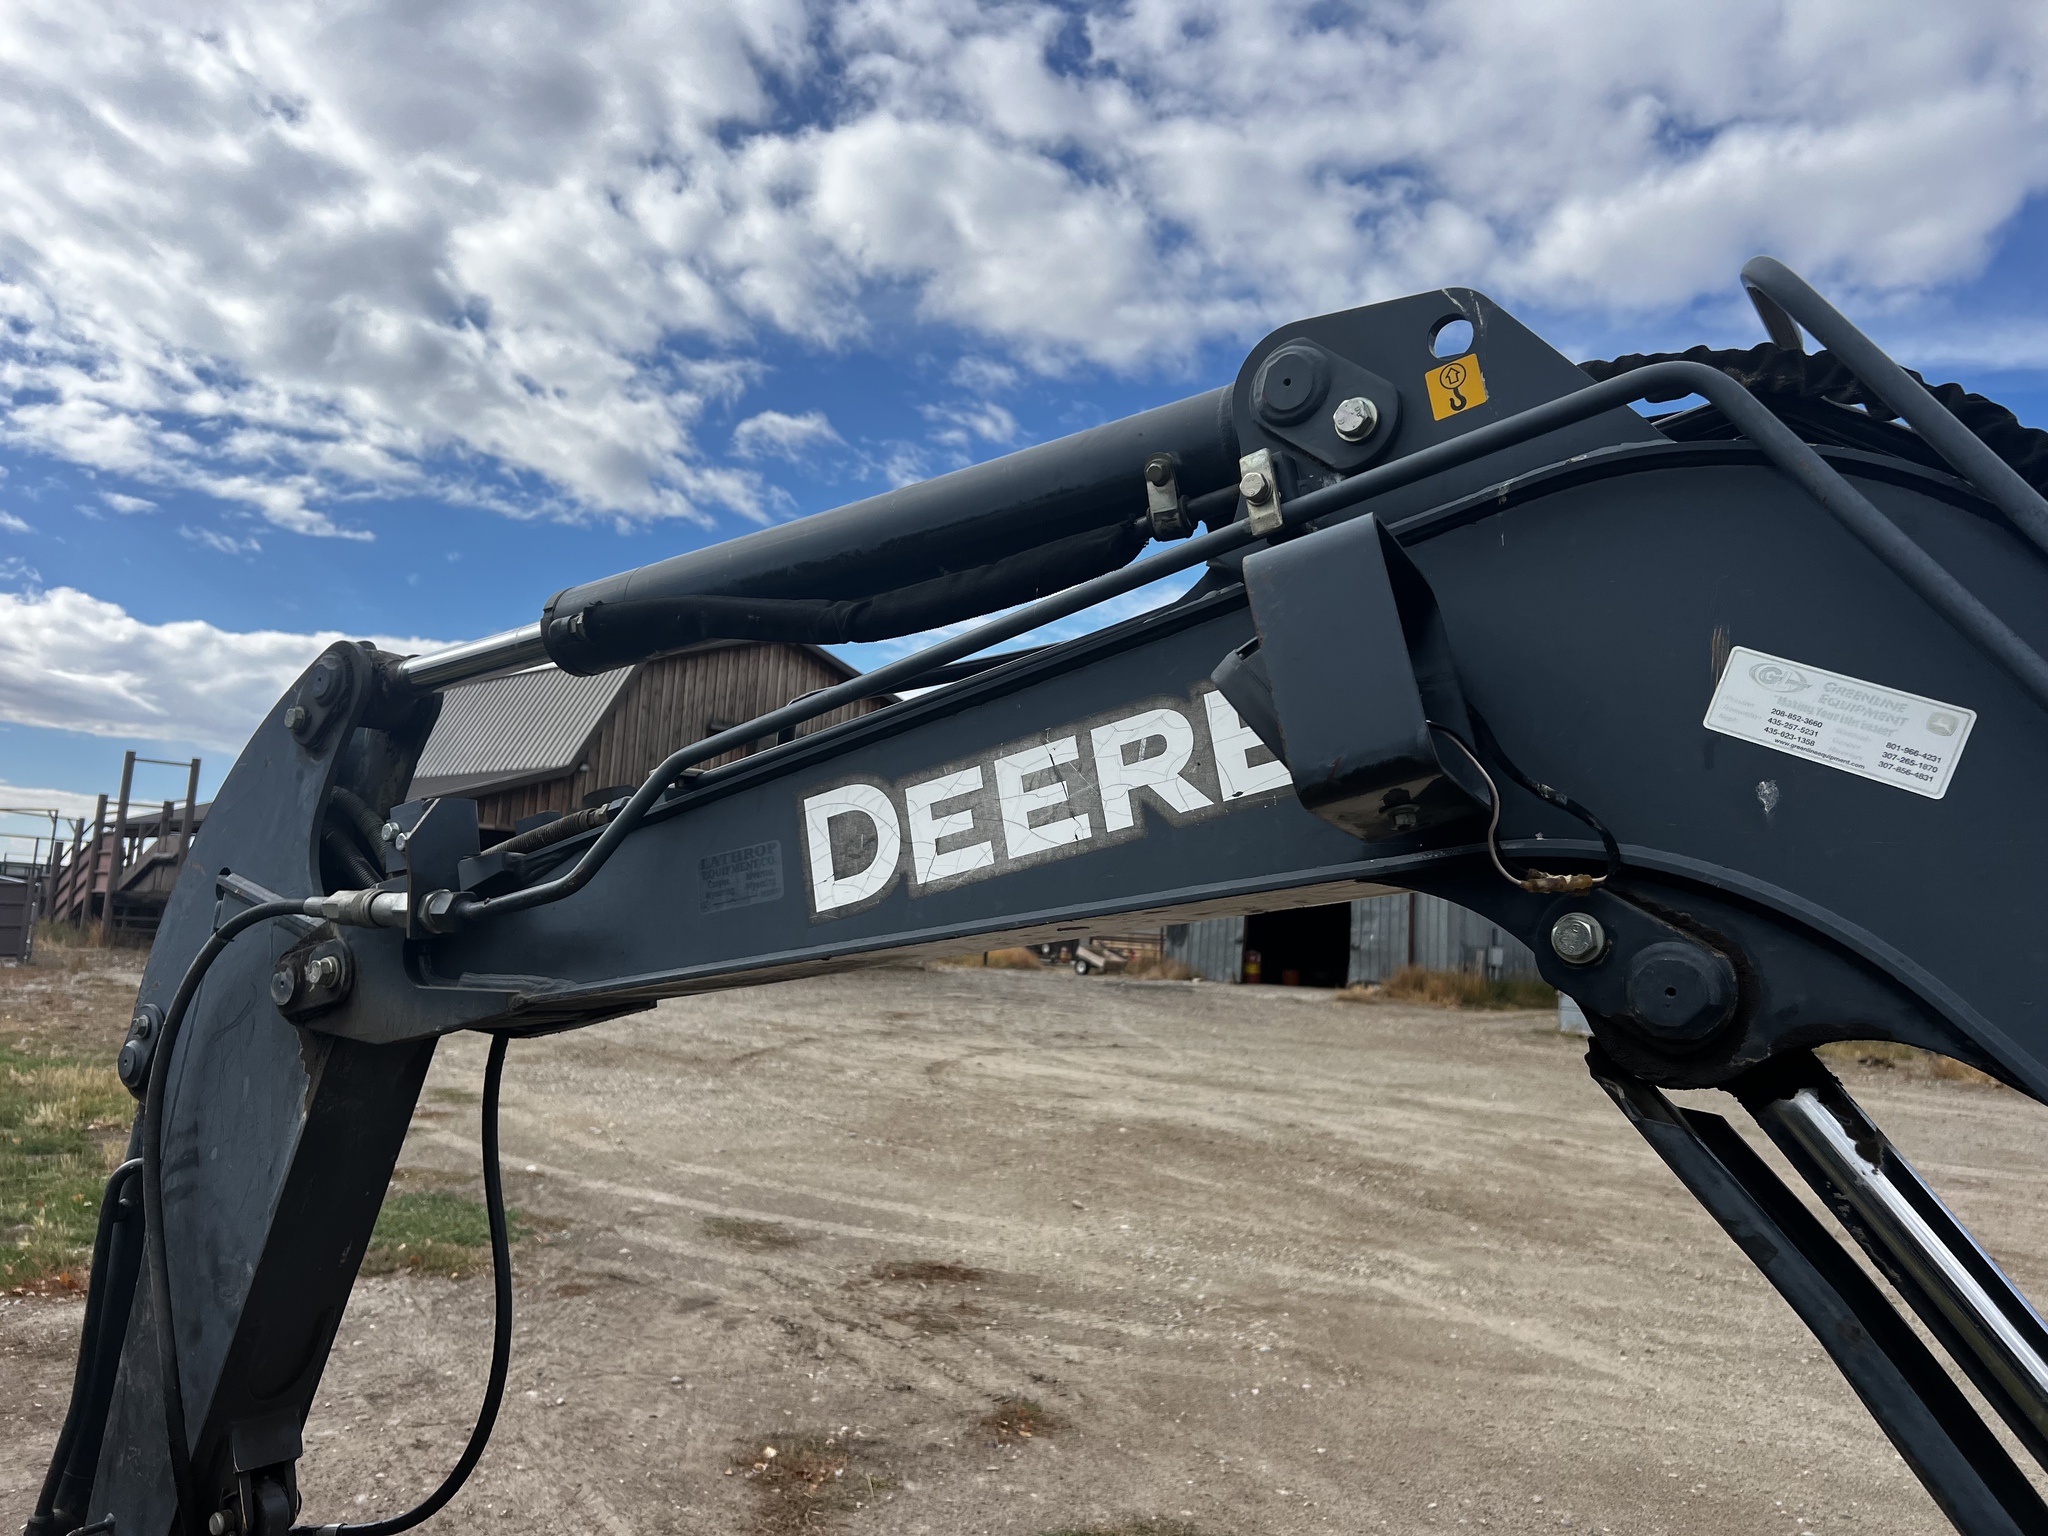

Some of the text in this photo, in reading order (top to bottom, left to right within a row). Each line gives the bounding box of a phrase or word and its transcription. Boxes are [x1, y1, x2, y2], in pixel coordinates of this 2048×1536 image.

[1822, 681, 1909, 713] GREENLINE
[1770, 707, 1824, 729] 208-852-3660
[1816, 707, 1841, 721] Your
[1818, 694, 1910, 726] EQUIPMENT
[1763, 726, 1816, 747] 435-623-1358
[1767, 717, 1819, 738] 435-257-5231
[1774, 737, 1866, 769] www.greenlineequipment.com
[1882, 751, 1938, 773] 307-265-1870
[1878, 760, 1934, 783] 307-856-4831
[803, 689, 1293, 913] DEERE
[699, 841, 778, 870] LATHROP
